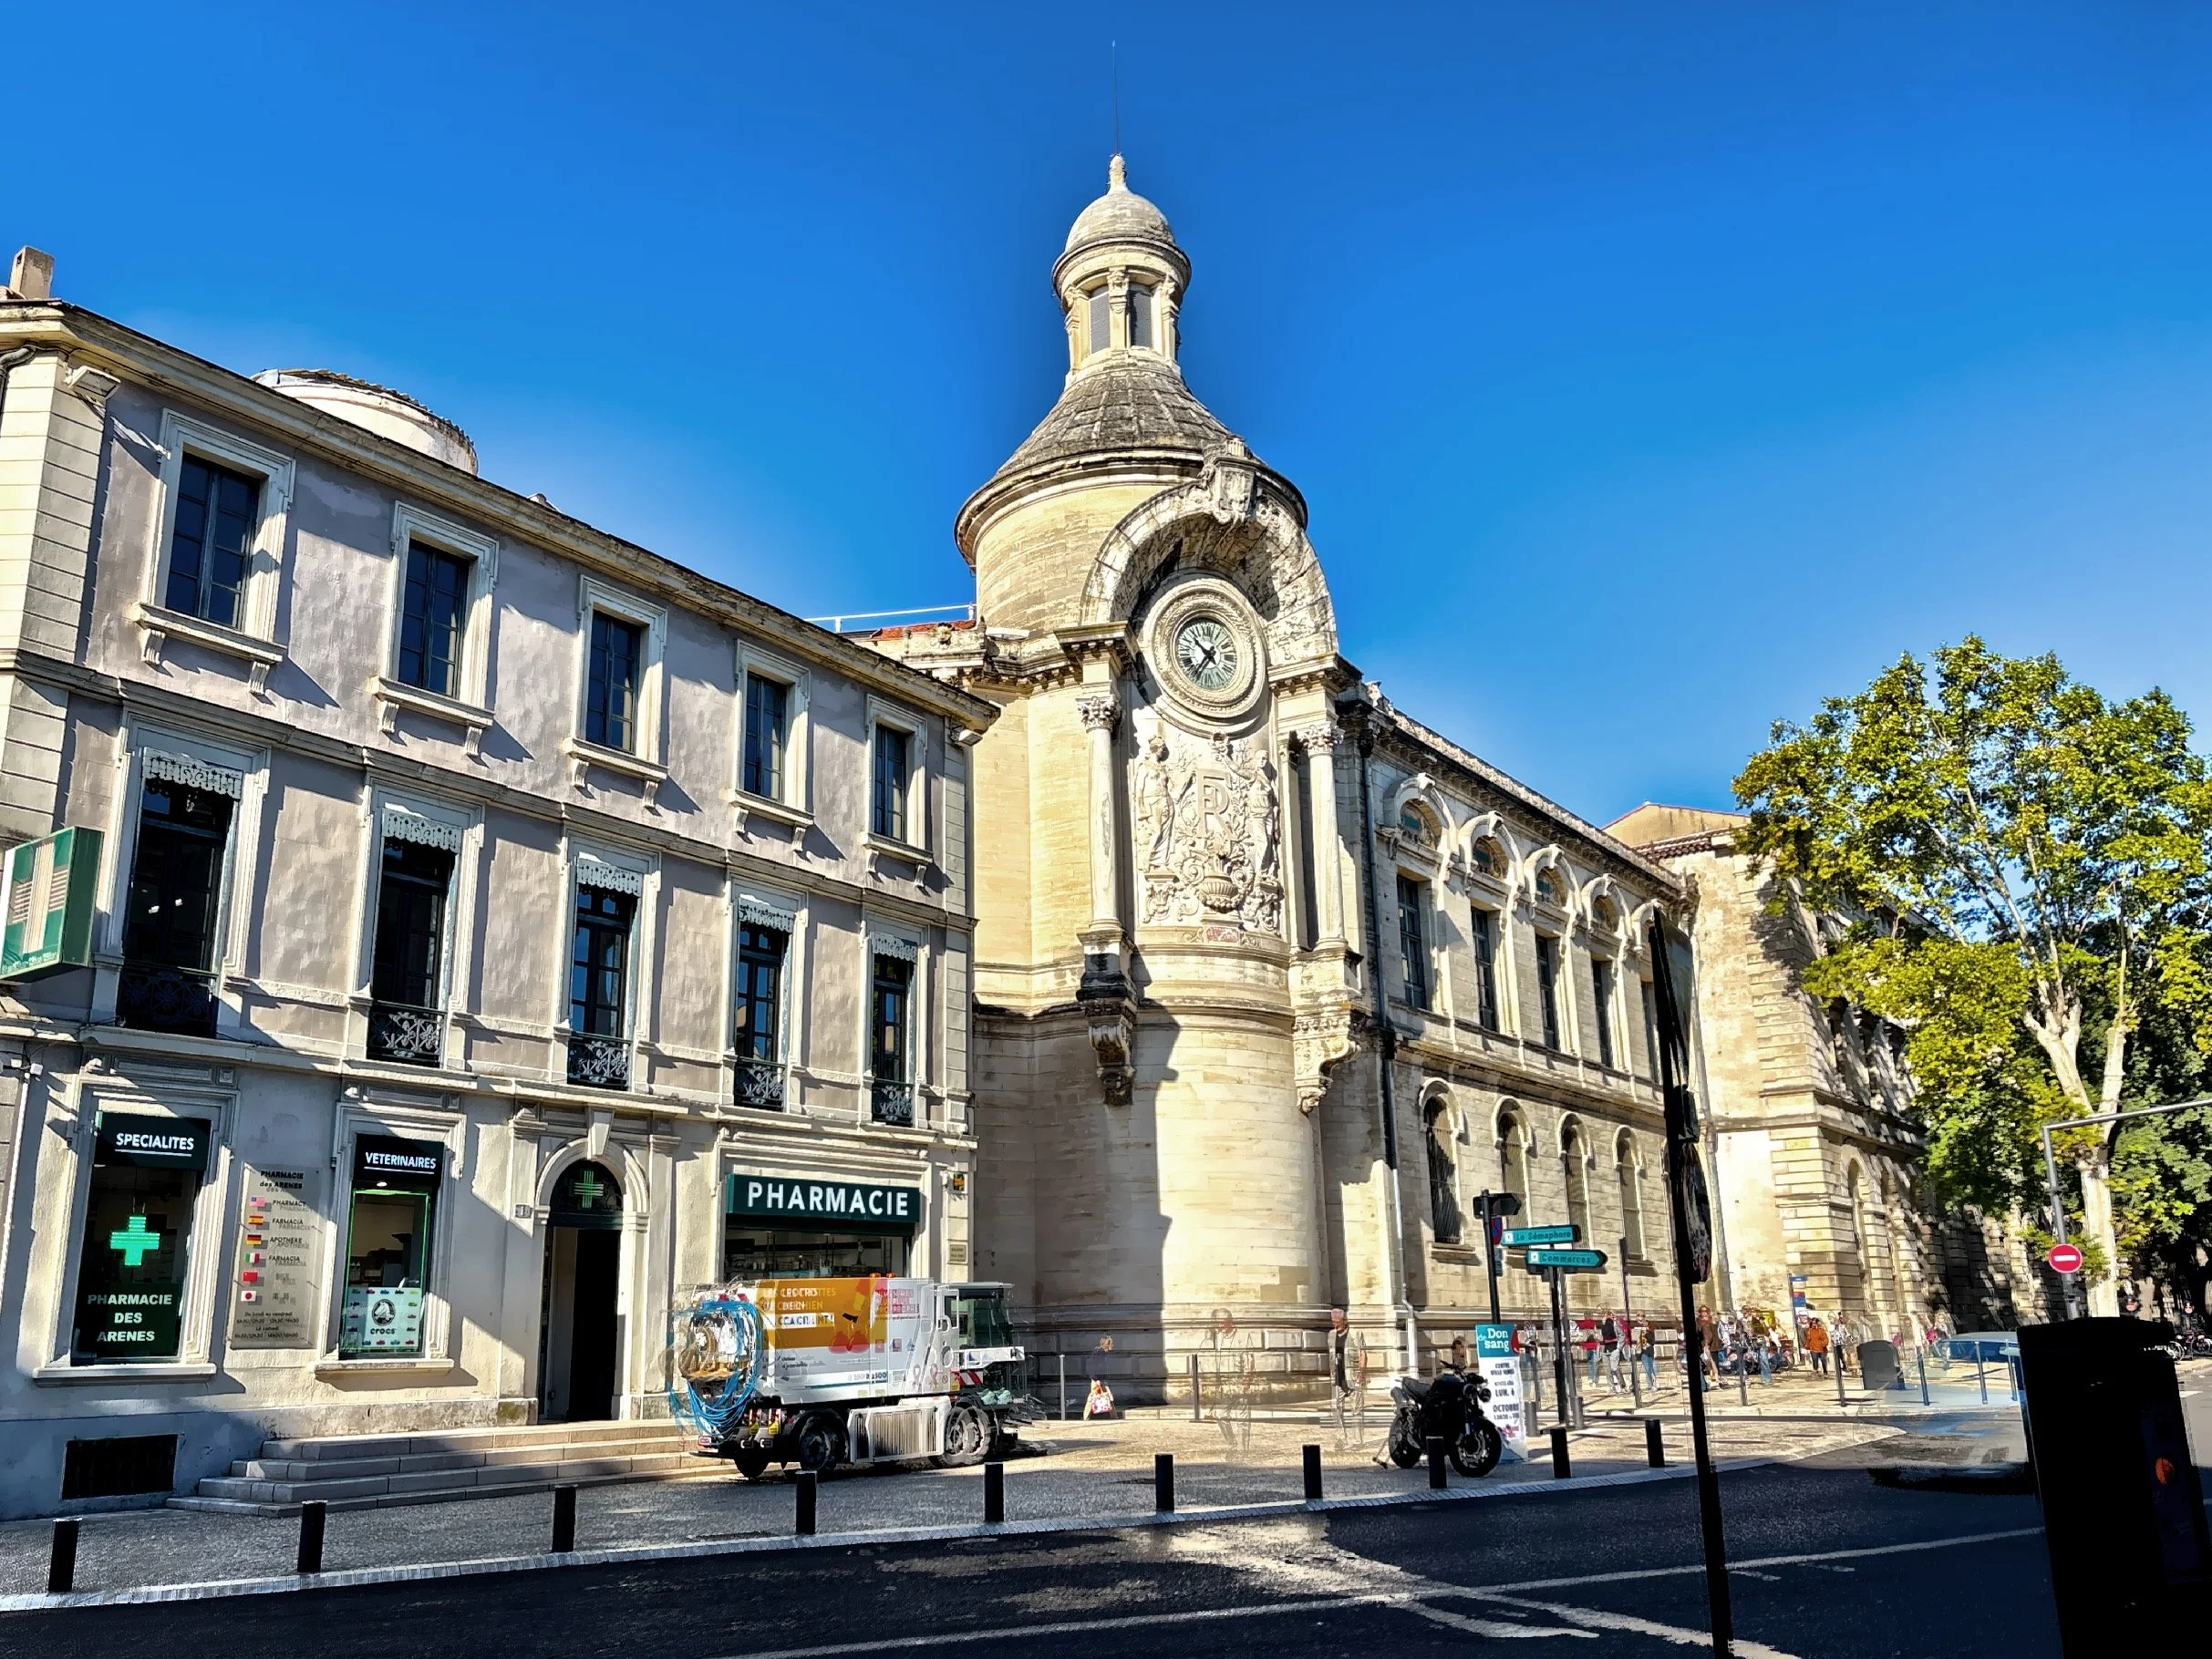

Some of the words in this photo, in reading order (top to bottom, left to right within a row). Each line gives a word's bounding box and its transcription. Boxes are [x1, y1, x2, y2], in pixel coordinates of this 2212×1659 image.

[116, 1132, 194, 1150] SPECIALITES
[365, 1151, 437, 1170] VETERINAIRES
[261, 1170, 305, 1180] PHARMACIE
[274, 1181, 303, 1190] ARENES
[748, 1181, 908, 1216] PHARMACIE
[269, 1236, 303, 1244] APOTHEKE
[1528, 1230, 1571, 1241] Sémaphore
[1542, 1253, 1591, 1263] Commerces
[88, 1294, 172, 1305] PHARMACIE
[114, 1313, 142, 1324] DES
[97, 1331, 155, 1342] ARENES
[1487, 1328, 1508, 1339] Don
[1484, 1340, 1509, 1353] sang
